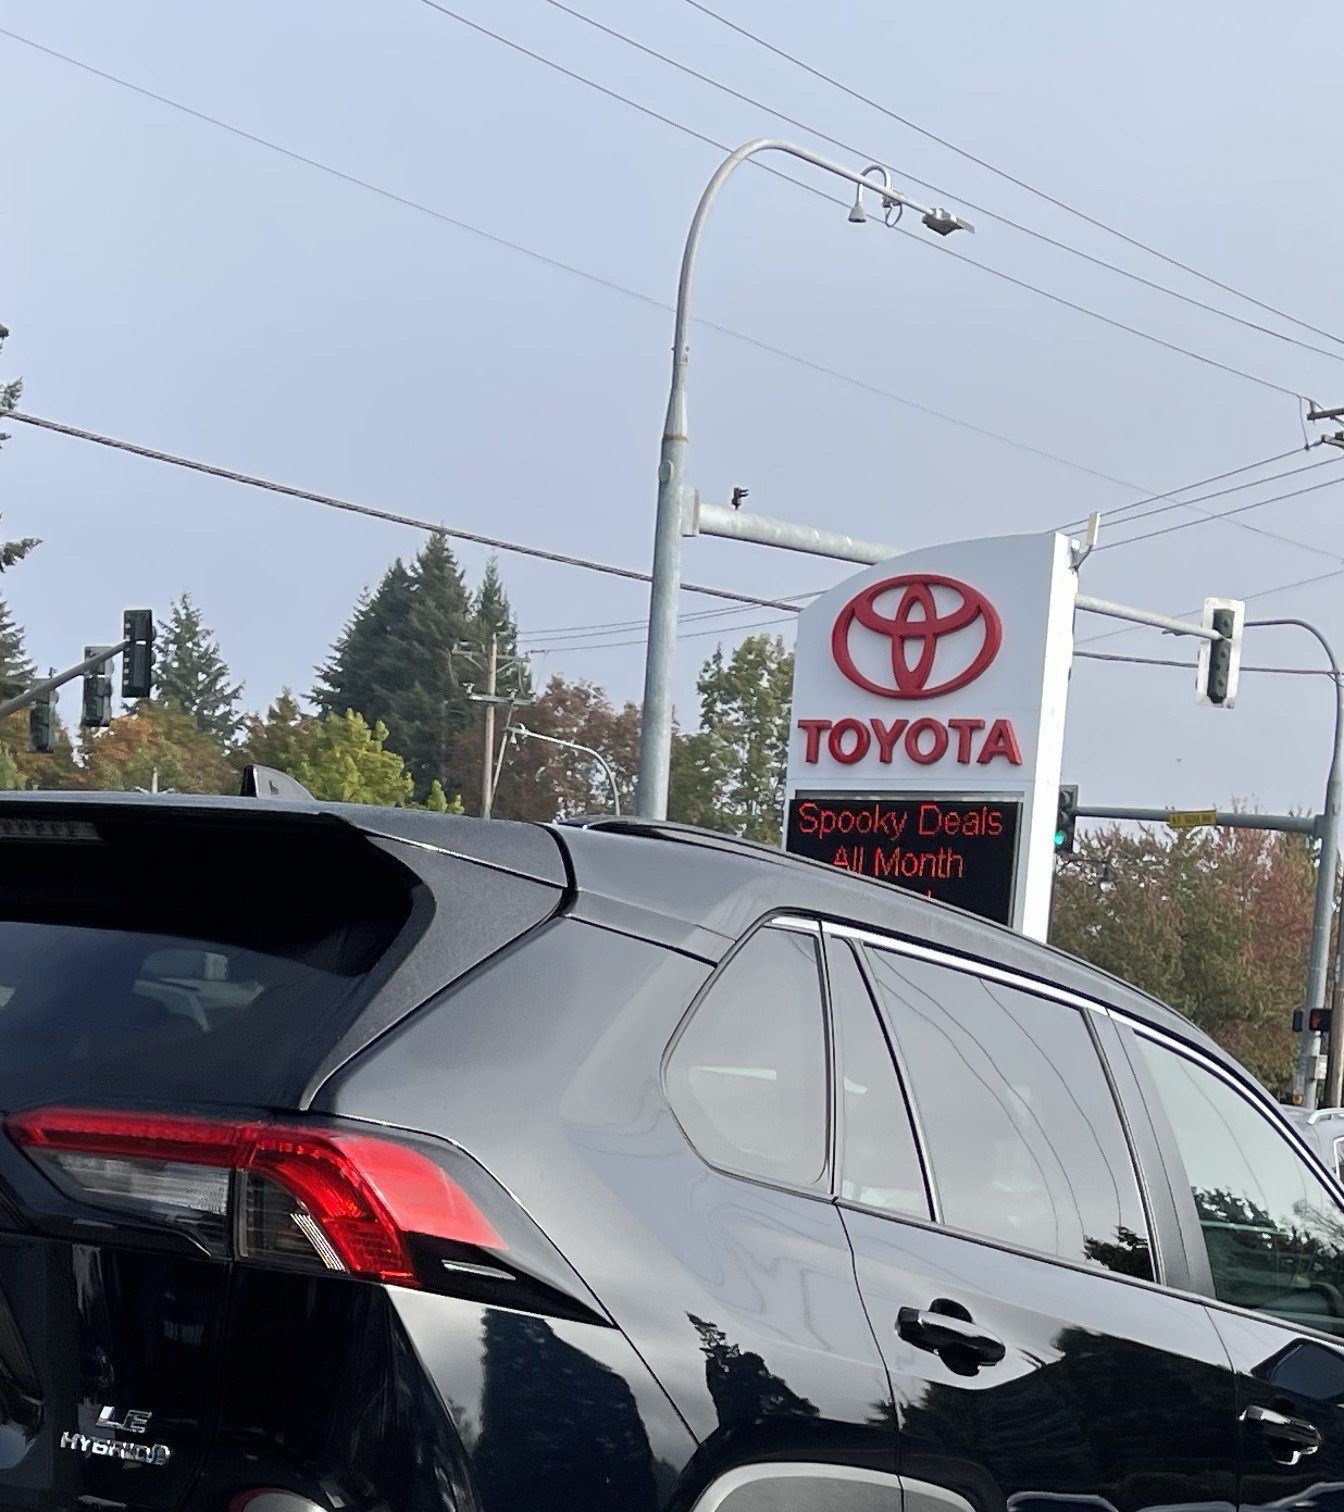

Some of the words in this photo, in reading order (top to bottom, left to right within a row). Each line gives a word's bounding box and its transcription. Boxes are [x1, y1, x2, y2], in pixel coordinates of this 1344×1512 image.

[797, 717, 1023, 766] TOYOTA
[798, 802, 908, 841] Spooky
[918, 802, 1005, 836] Deals
[833, 845, 865, 874] All
[874, 846, 964, 879] Month
[96, 1405, 153, 1433] LE
[60, 1431, 171, 1466] HYBRID
